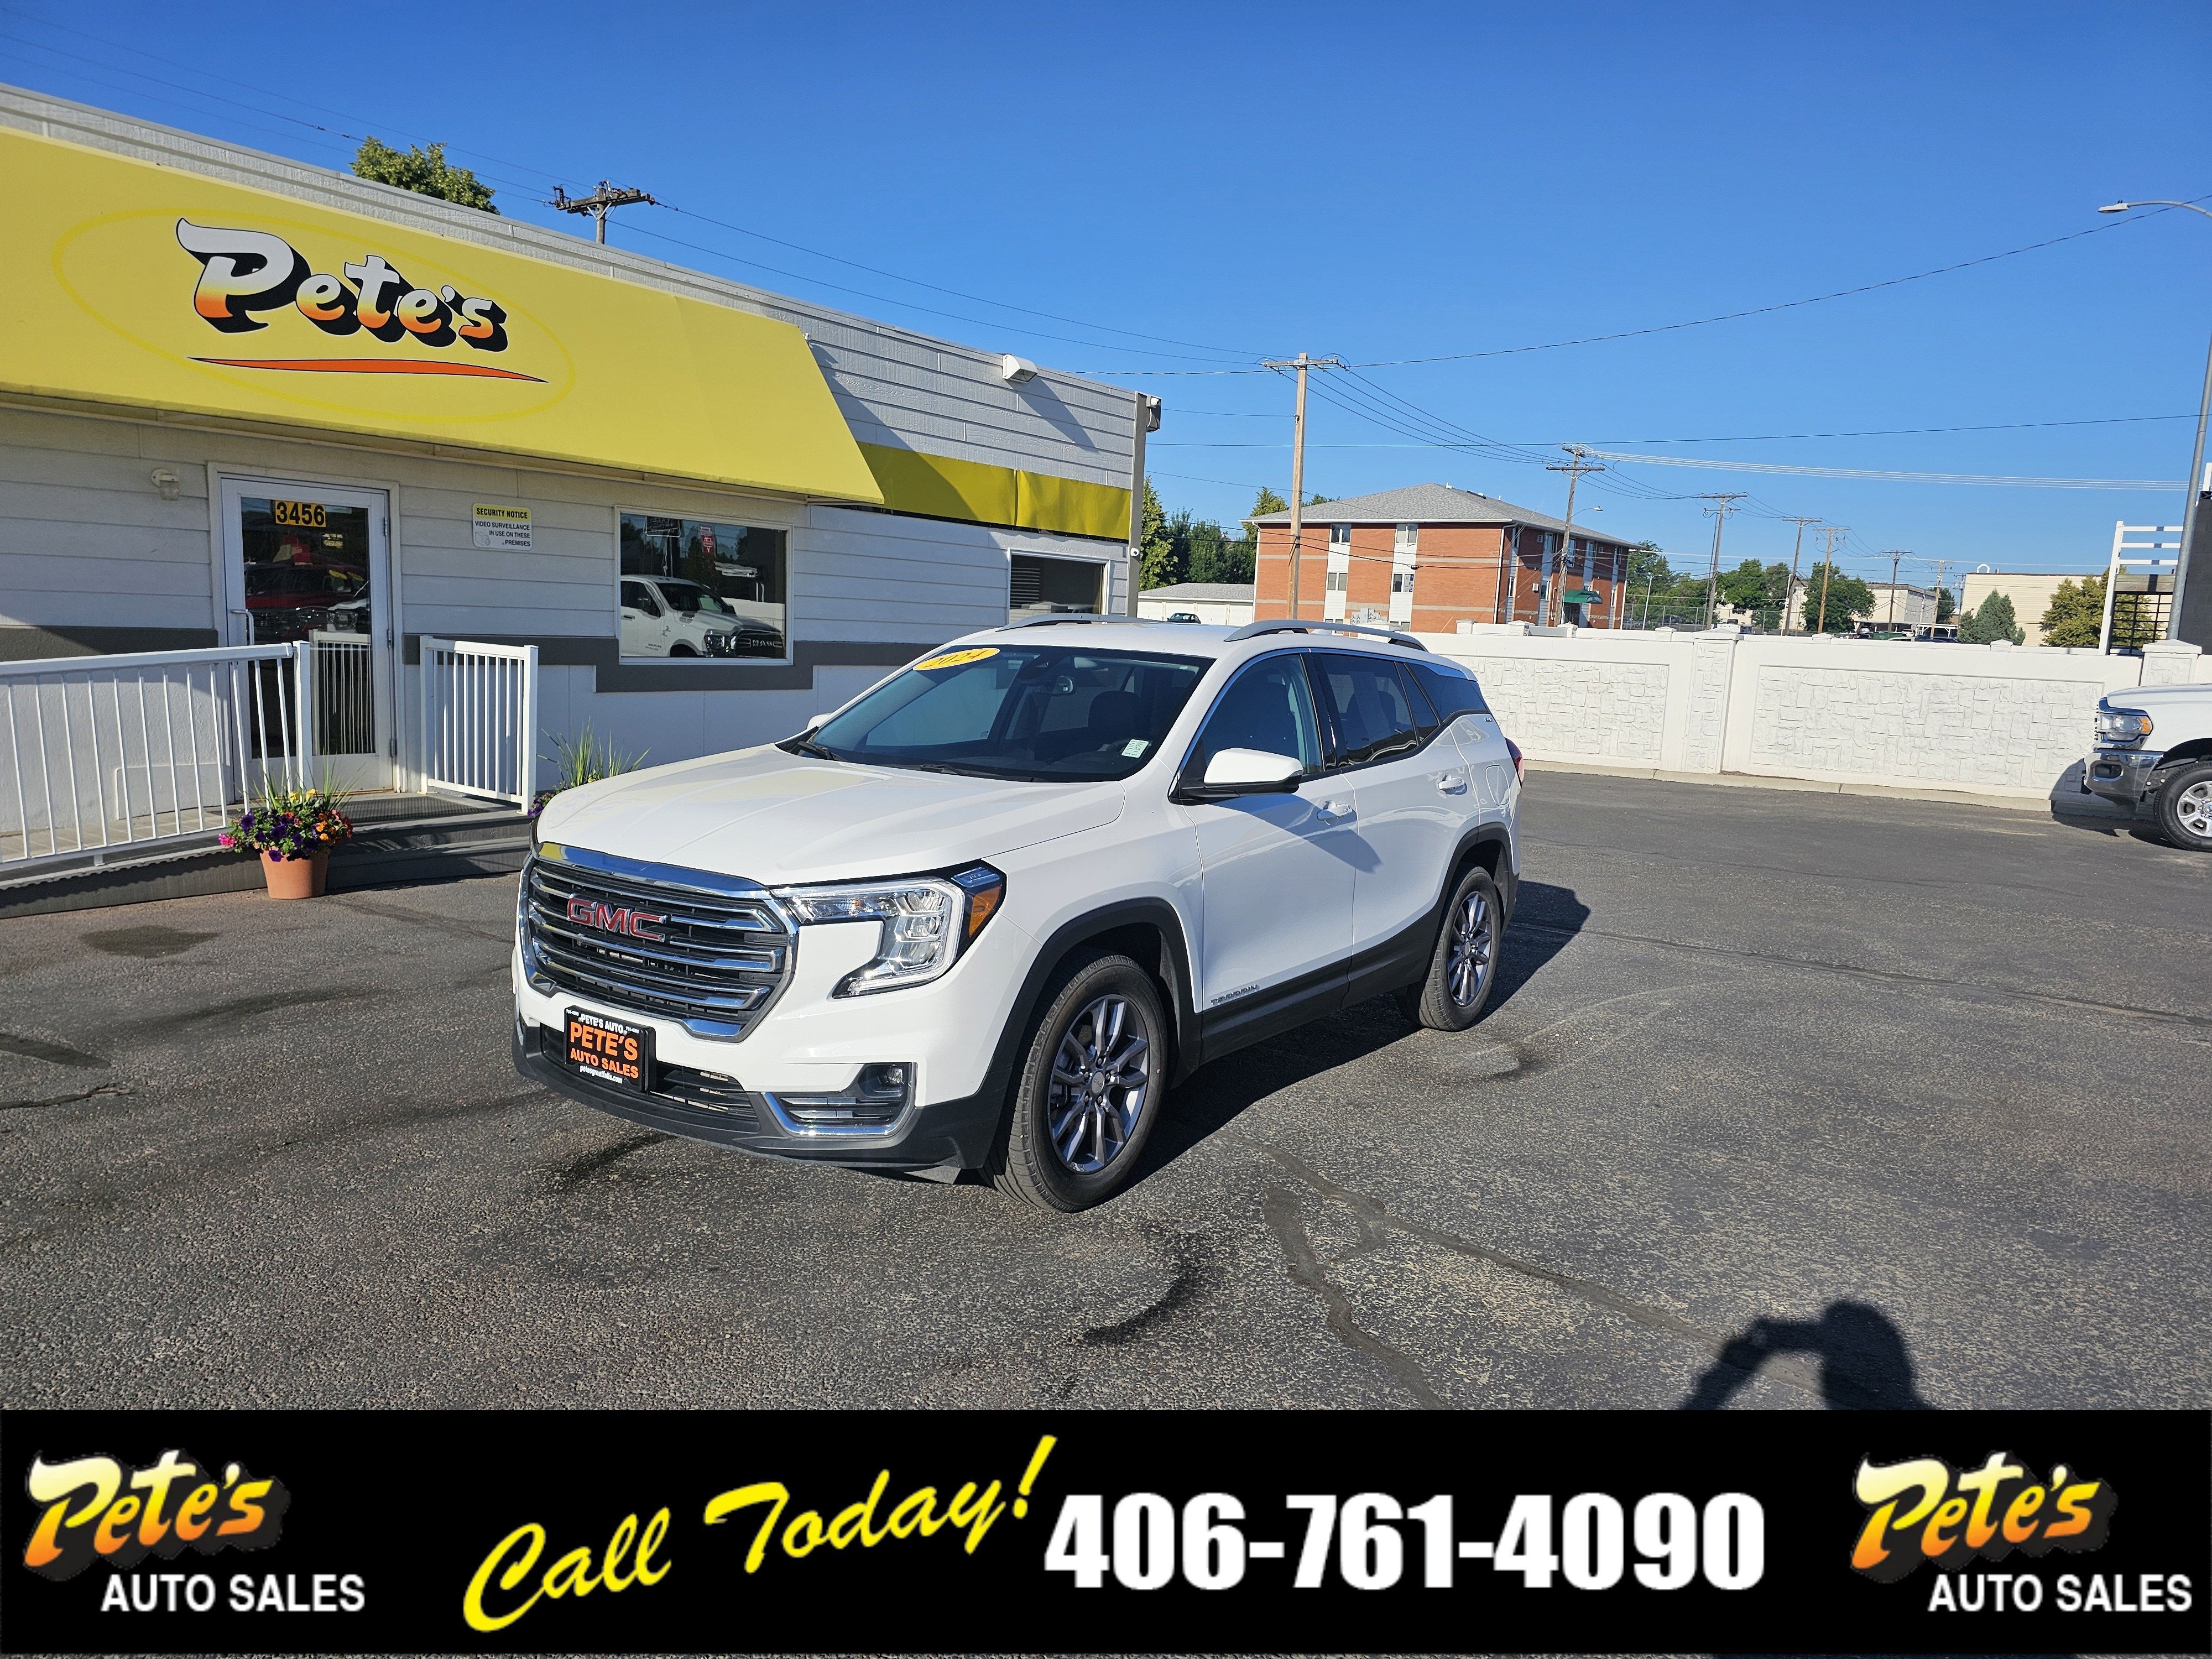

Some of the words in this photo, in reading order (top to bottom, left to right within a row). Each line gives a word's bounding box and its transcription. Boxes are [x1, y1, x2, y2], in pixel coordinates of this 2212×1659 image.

[176, 218, 508, 351] Pete's
[276, 502, 325, 526] 3456
[477, 508, 505, 517] SECURITY
[507, 510, 528, 519] NOTICE
[492, 522, 530, 530] SURVEILLANCE
[924, 649, 989, 669] 2024
[567, 897, 666, 942] GMC
[581, 1013, 604, 1029] PETE'S
[605, 1020, 624, 1034] AUTO
[570, 1021, 638, 1061] PETE'S
[570, 1048, 599, 1067] AUTO
[601, 1057, 639, 1078] SALES
